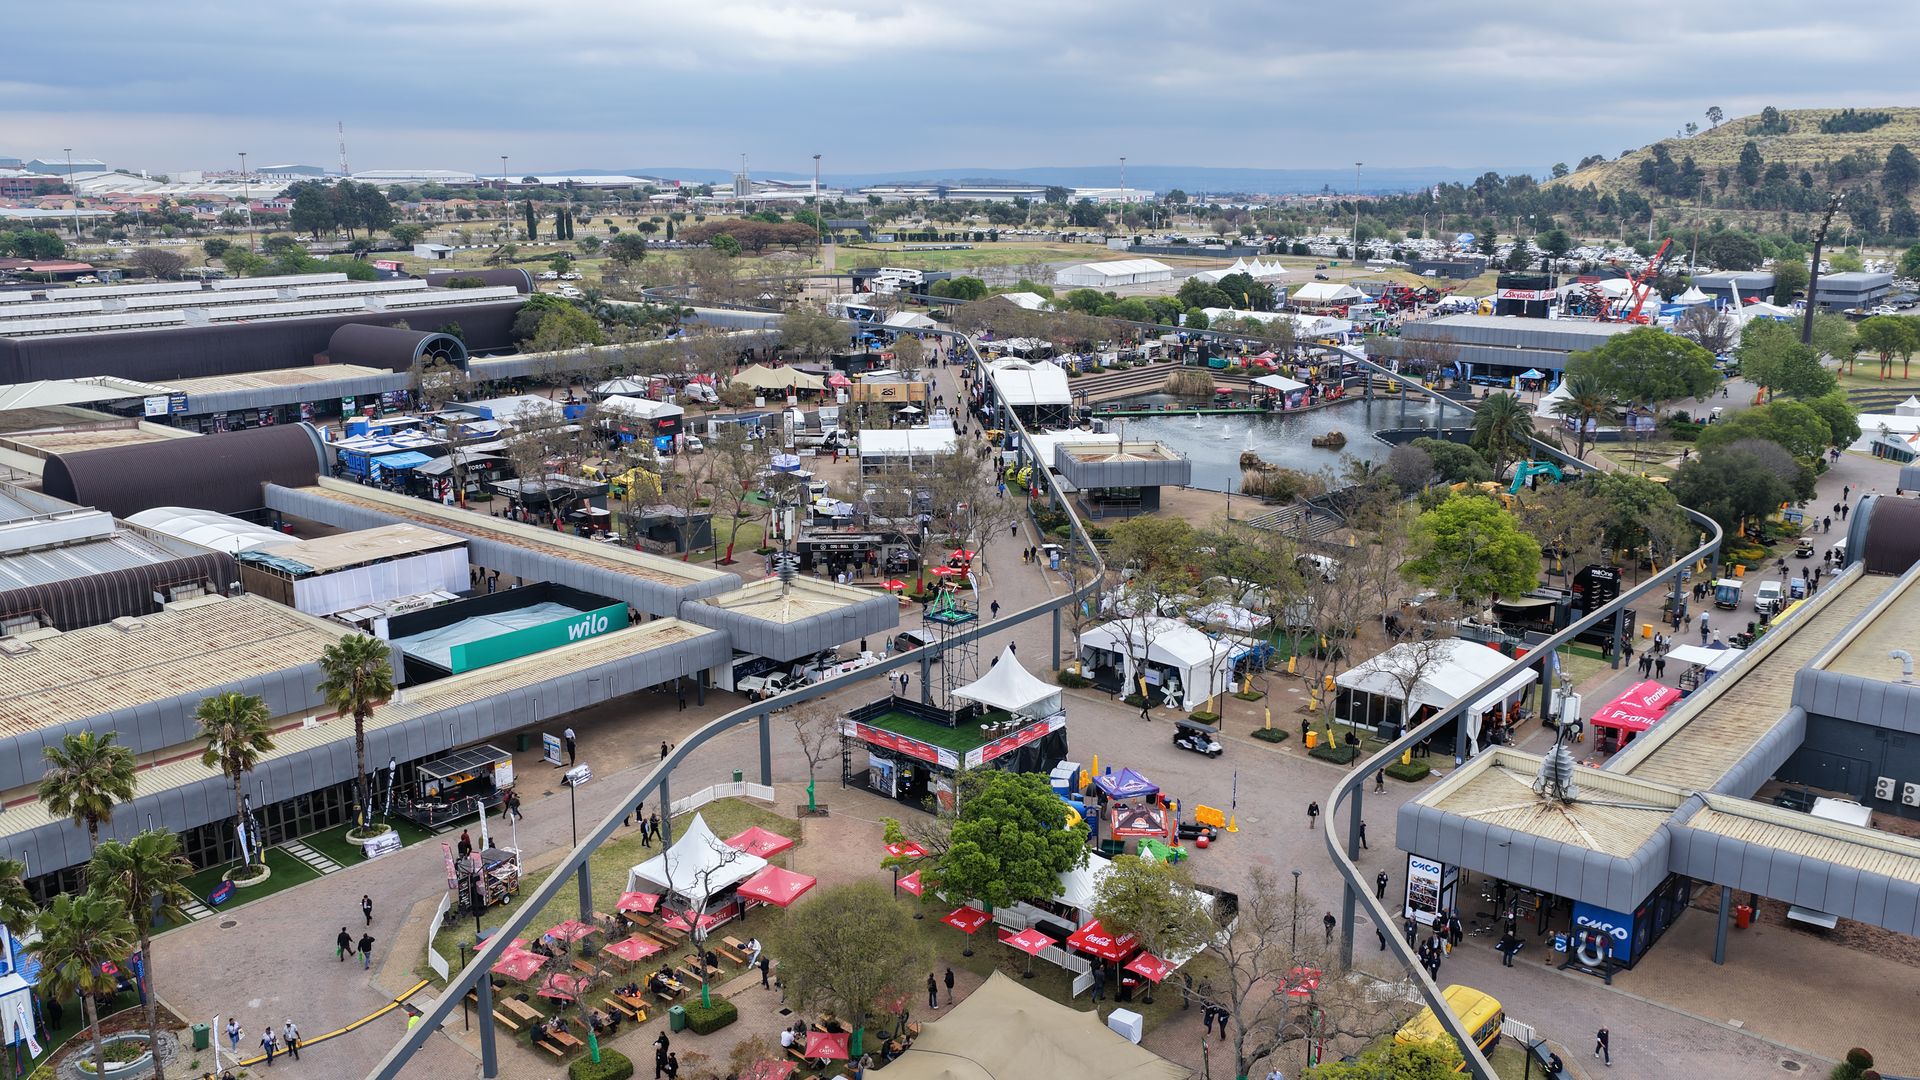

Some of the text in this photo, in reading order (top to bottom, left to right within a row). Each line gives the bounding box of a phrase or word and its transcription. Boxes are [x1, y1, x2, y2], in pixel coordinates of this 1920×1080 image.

[568, 613, 608, 640] wilo
[1643, 686, 1668, 706] Fronius
[1411, 860, 1439, 874] CMCO
[951, 919, 967, 928] Coca-Cola
[1576, 915, 1628, 940] CMCO
[1085, 933, 1111, 947] Coca-Cola
[1135, 963, 1153, 974] Coca-Cola
